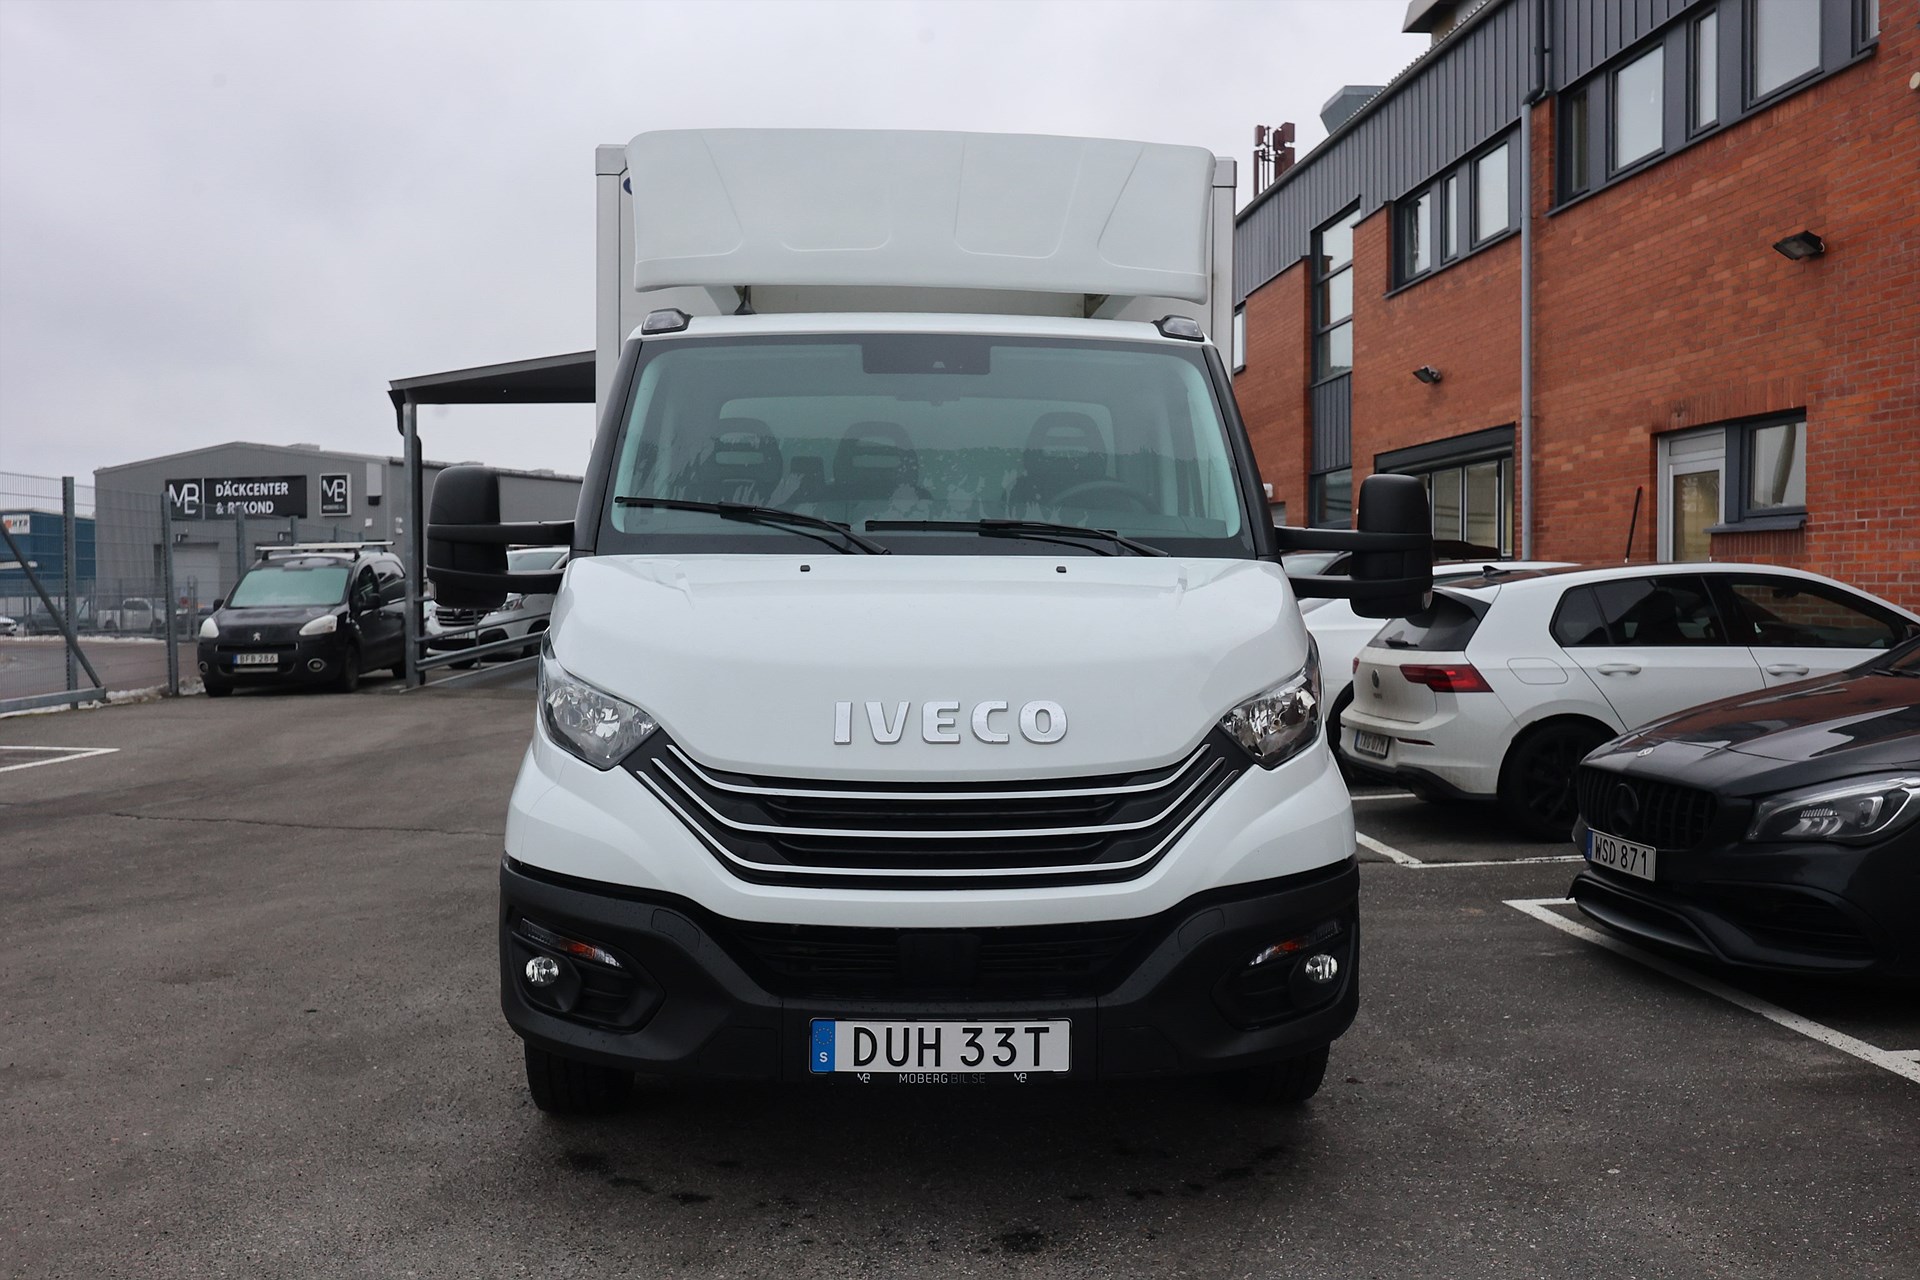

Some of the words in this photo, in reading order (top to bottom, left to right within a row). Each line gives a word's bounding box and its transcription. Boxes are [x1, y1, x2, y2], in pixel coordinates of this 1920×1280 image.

[215, 481, 289, 497] DÄCKCENTER
[215, 502, 224, 515] &
[834, 700, 1068, 745] IVECO
[1595, 835, 1616, 864] WSD
[1620, 844, 1648, 875] 871
[819, 1051, 828, 1063] S
[853, 1026, 942, 1067] DUH
[960, 1027, 1050, 1067] 33T
